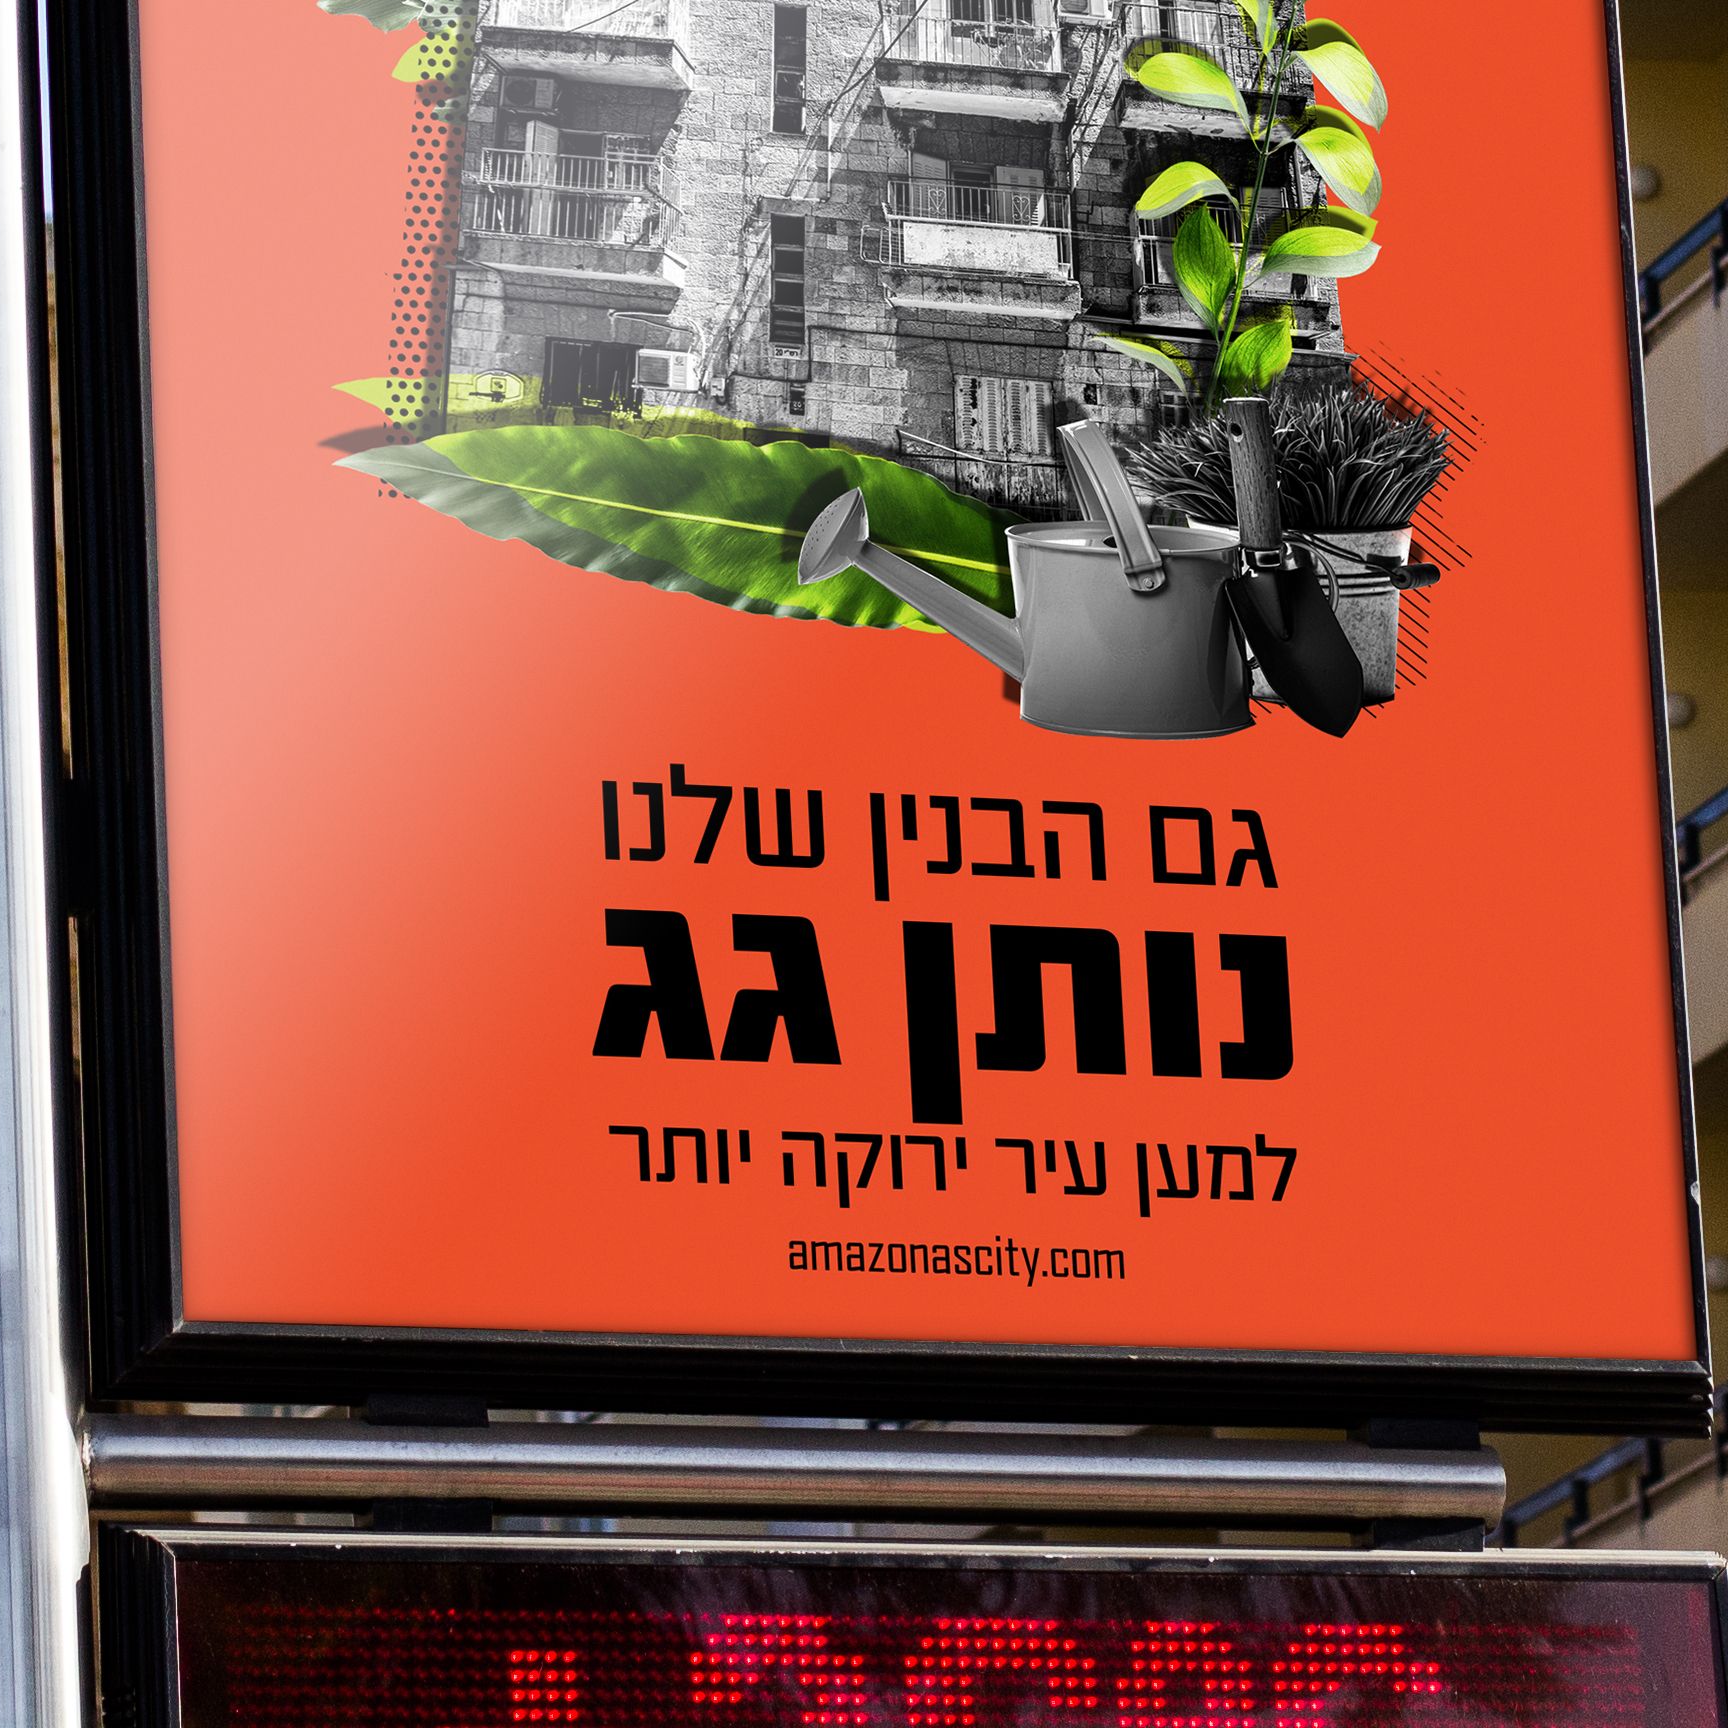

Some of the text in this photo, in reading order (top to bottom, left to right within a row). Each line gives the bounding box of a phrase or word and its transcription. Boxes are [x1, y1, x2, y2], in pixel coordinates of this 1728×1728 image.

[601, 763, 1279, 902] גם הבנין שלנו
[592, 908, 1294, 1126] נותן גג
[608, 1125, 1298, 1218] למען עיר ירוקה יותר
[788, 1235, 1125, 1288] amazonascity.com
